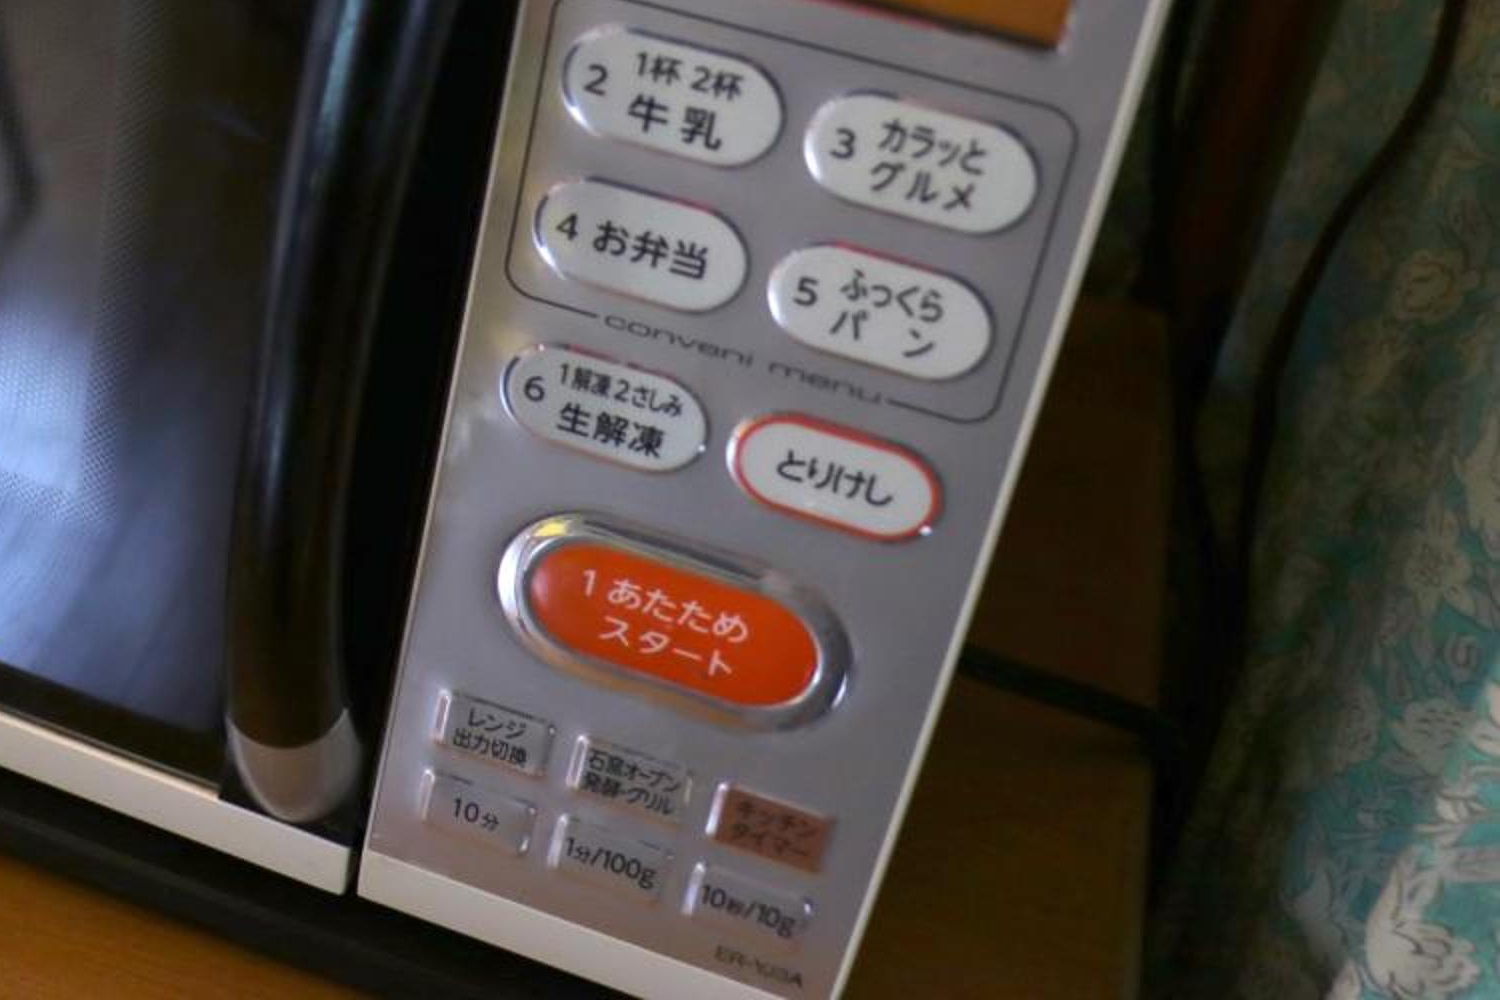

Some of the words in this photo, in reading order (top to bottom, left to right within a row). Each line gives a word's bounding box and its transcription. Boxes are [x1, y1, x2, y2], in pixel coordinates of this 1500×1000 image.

[583, 64, 607, 96] 2
[635, 52, 683, 81] 1杯
[693, 66, 745, 98] 2杯
[627, 96, 721, 151] 牛乳
[830, 129, 854, 159] 3
[877, 120, 988, 176] カラッと
[868, 160, 976, 212] グルメ
[555, 214, 579, 242] 4
[593, 219, 709, 281] お弁当
[793, 278, 818, 307] 5
[840, 270, 943, 323] ふっくら
[604, 312, 754, 367] conveni
[769, 362, 885, 404] menu
[829, 309, 937, 359] パン
[524, 376, 546, 404] 6
[555, 402, 667, 460] 生解凍
[776, 453, 894, 507] とりけし
[582, 569, 596, 597] 1
[608, 578, 749, 645] あたため
[598, 614, 734, 677] スタート
[468, 708, 528, 739] レンジ
[453, 797, 500, 832] 10分
[565, 837, 658, 890] 1分/100g
